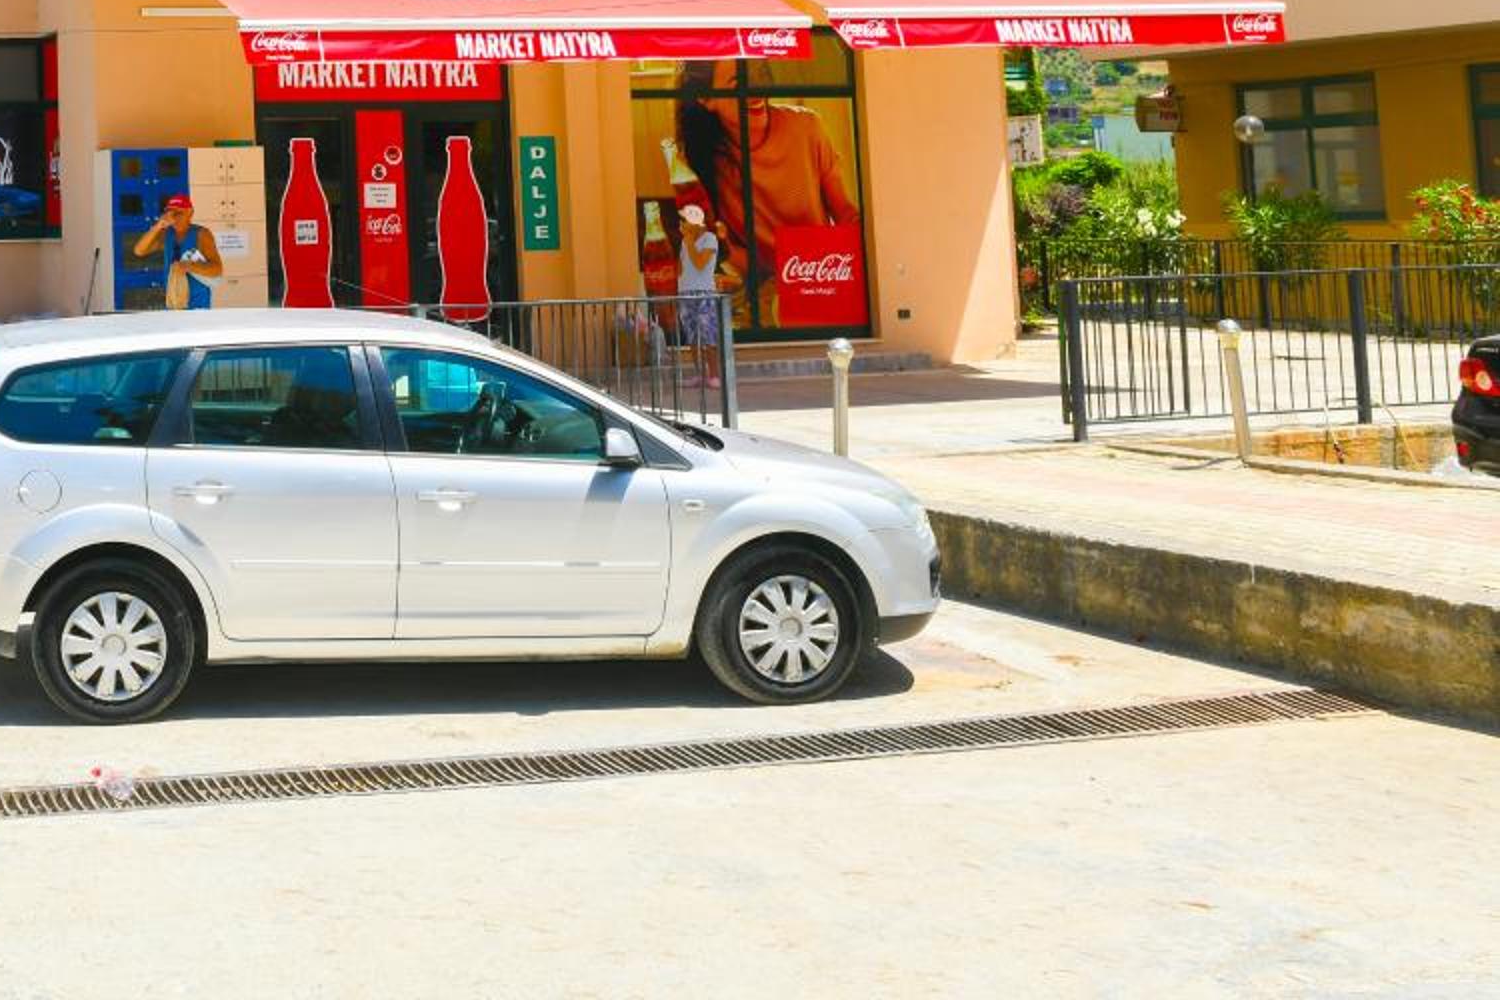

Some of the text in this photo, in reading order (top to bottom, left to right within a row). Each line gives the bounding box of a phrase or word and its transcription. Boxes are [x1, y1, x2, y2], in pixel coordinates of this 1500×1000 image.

[995, 17, 1133, 43] MARKET NATYRA
[455, 31, 617, 59] MARKET NATYRA
[278, 61, 479, 88] MARKET NATYRA
[530, 146, 549, 239] DALJE
[782, 253, 853, 284] Coca-Cola
